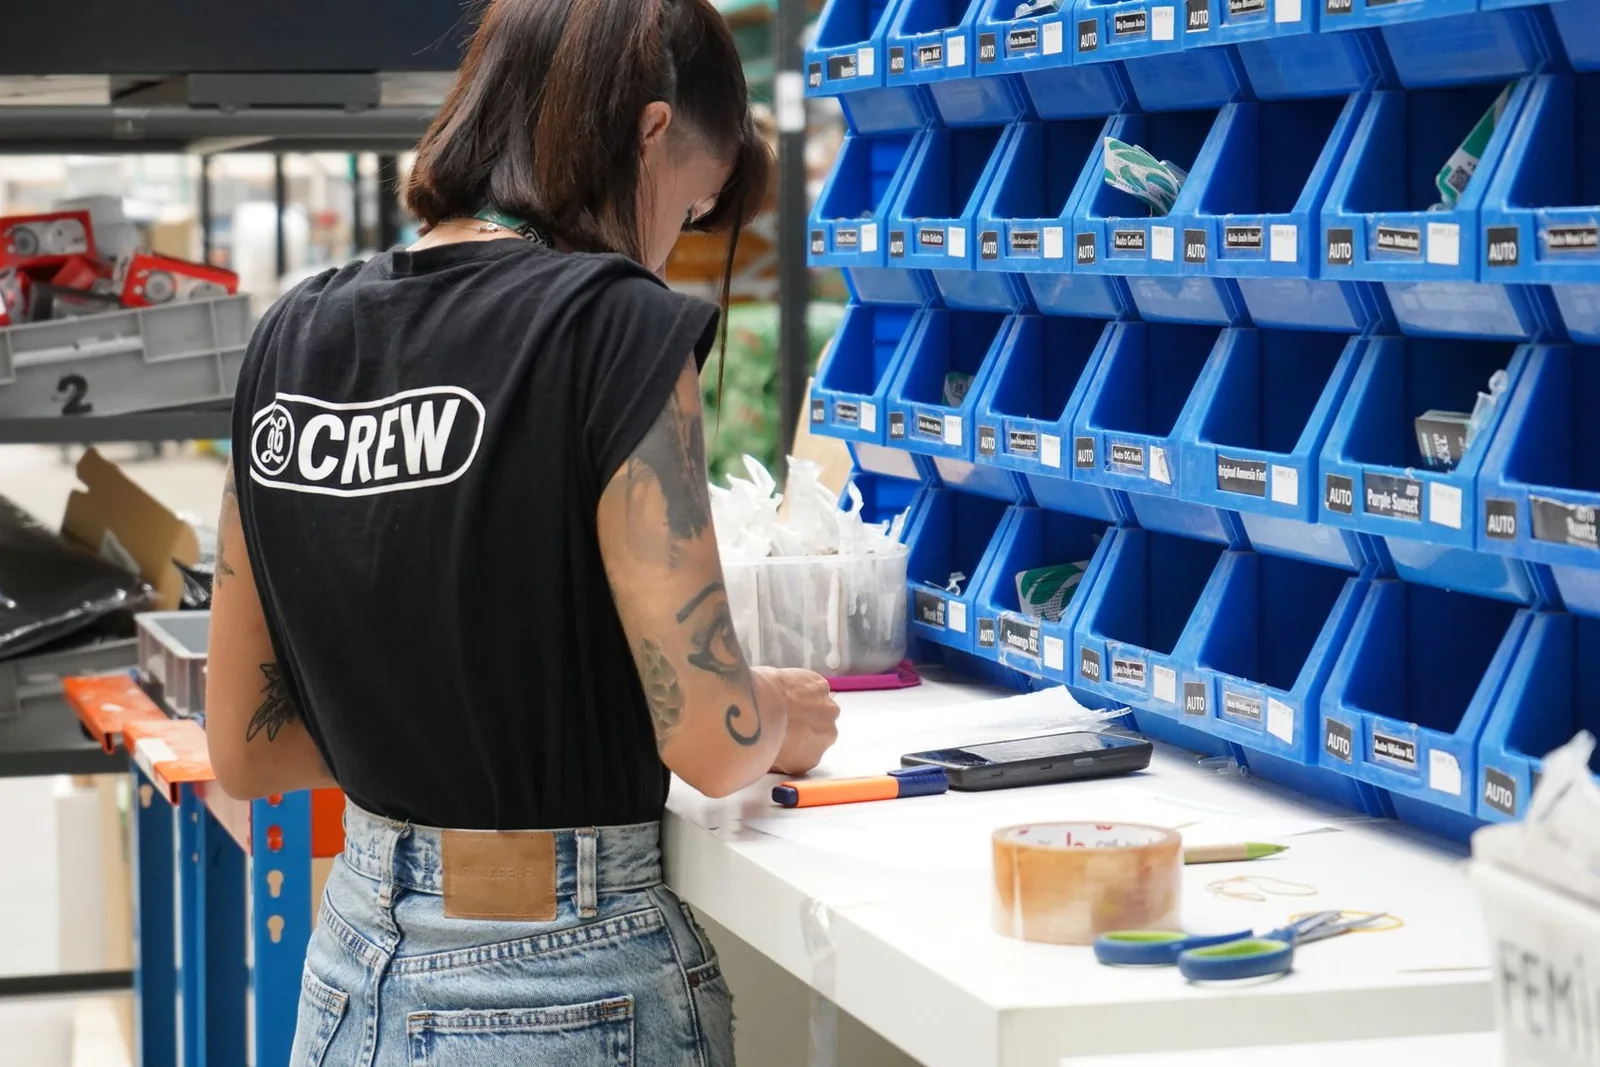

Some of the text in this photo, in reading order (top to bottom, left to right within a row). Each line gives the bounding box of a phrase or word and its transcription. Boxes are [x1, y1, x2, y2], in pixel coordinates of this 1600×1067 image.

[1190, 10, 1208, 25] AUTO
[1081, 33, 1097, 47] AUTO
[980, 46, 995, 58] AUTO
[891, 57, 904, 69] AUTO
[891, 241, 904, 253] AUTO
[1116, 235, 1127, 245] Auto
[983, 242, 997, 254] AUTO
[1078, 245, 1094, 258] AUTO
[1187, 244, 1206, 258] AUTO
[1328, 243, 1351, 258] AUTO
[1489, 243, 1516, 260] AUTO
[57, 374, 93, 416] 2
[892, 423, 904, 435] AUTO
[298, 399, 461, 485] CREW
[981, 437, 995, 449] AUTO
[1078, 449, 1094, 462] AUTO
[1218, 465, 1236, 479] Original
[1236, 467, 1255, 481] Amnesia
[1329, 488, 1352, 505] AUTO
[1367, 488, 1419, 514] Purple Sunset
[1488, 515, 1514, 534] AUTO
[980, 630, 994, 642] AUTO
[1082, 659, 1099, 677] AUTO
[1186, 696, 1205, 711] AUTO
[1327, 732, 1350, 755] AUTO
[1374, 739, 1388, 752] Auto
[1486, 782, 1512, 808] AUTO
[1498, 938, 1600, 1054] FEMI
